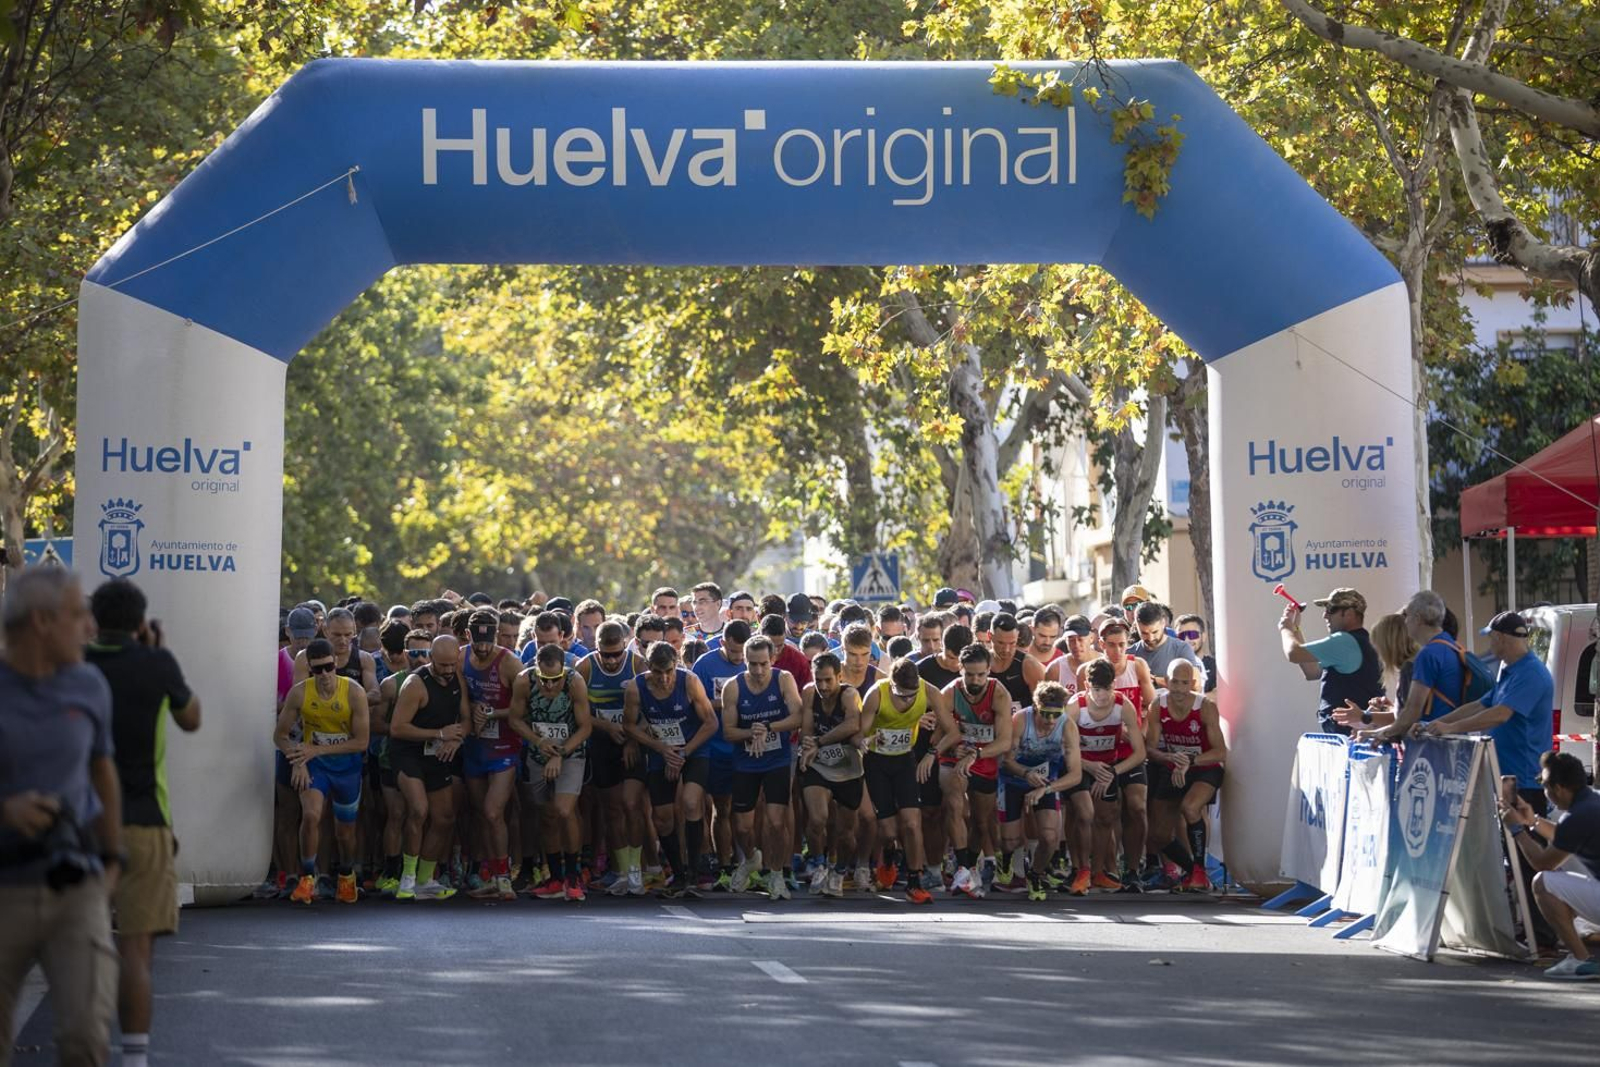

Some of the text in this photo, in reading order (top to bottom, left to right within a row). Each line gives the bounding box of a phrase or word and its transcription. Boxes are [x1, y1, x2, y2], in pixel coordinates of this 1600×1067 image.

[422, 106, 1078, 206] Huelva original
[101, 437, 241, 476] Huelva
[1248, 435, 1386, 476] Huelva
[191, 479, 240, 494] original
[1341, 475, 1387, 491] original
[150, 539, 238, 552] Ayuntamiento de
[1305, 538, 1388, 552] Ayuntamiento de
[149, 553, 236, 572] HUELVA
[1305, 551, 1389, 570] HUELVA
[548, 727, 567, 738] 376
[661, 727, 680, 737] 387
[972, 728, 991, 737] 311
[891, 734, 910, 745] 246
[822, 748, 843, 759] 388
